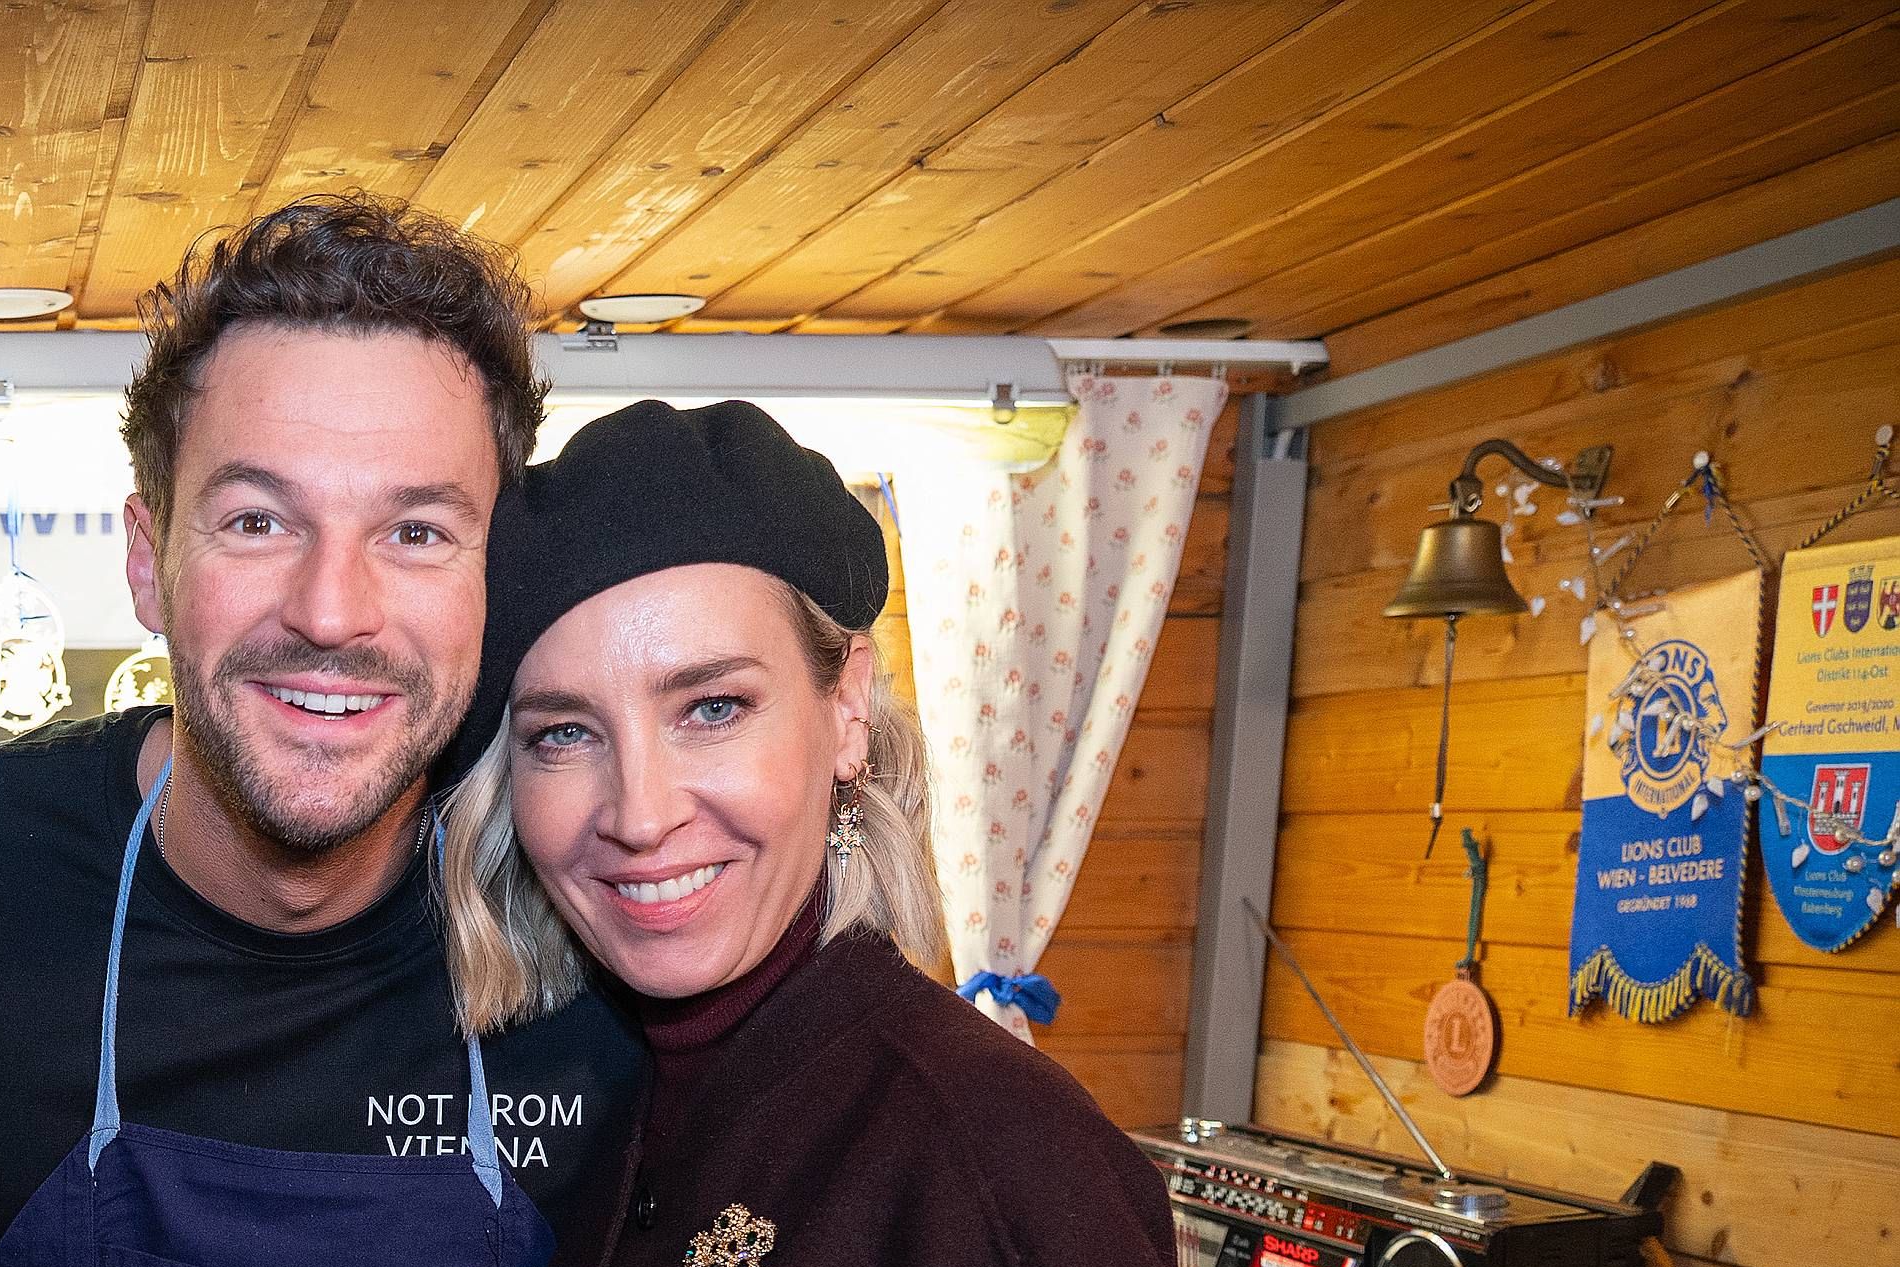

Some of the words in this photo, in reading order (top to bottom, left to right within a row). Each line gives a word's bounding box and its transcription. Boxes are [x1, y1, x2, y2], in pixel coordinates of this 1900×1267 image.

[1779, 720, 1825, 737] Gerhard
[1622, 838, 1664, 863] LIONS
[1667, 834, 1703, 857] CLUB
[1597, 868, 1637, 890] WIEN
[1648, 858, 1725, 886] BELVEDERE
[367, 1094, 453, 1126] NOT
[469, 1094, 582, 1126] ROM
[1263, 1234, 1319, 1263] SHARP
